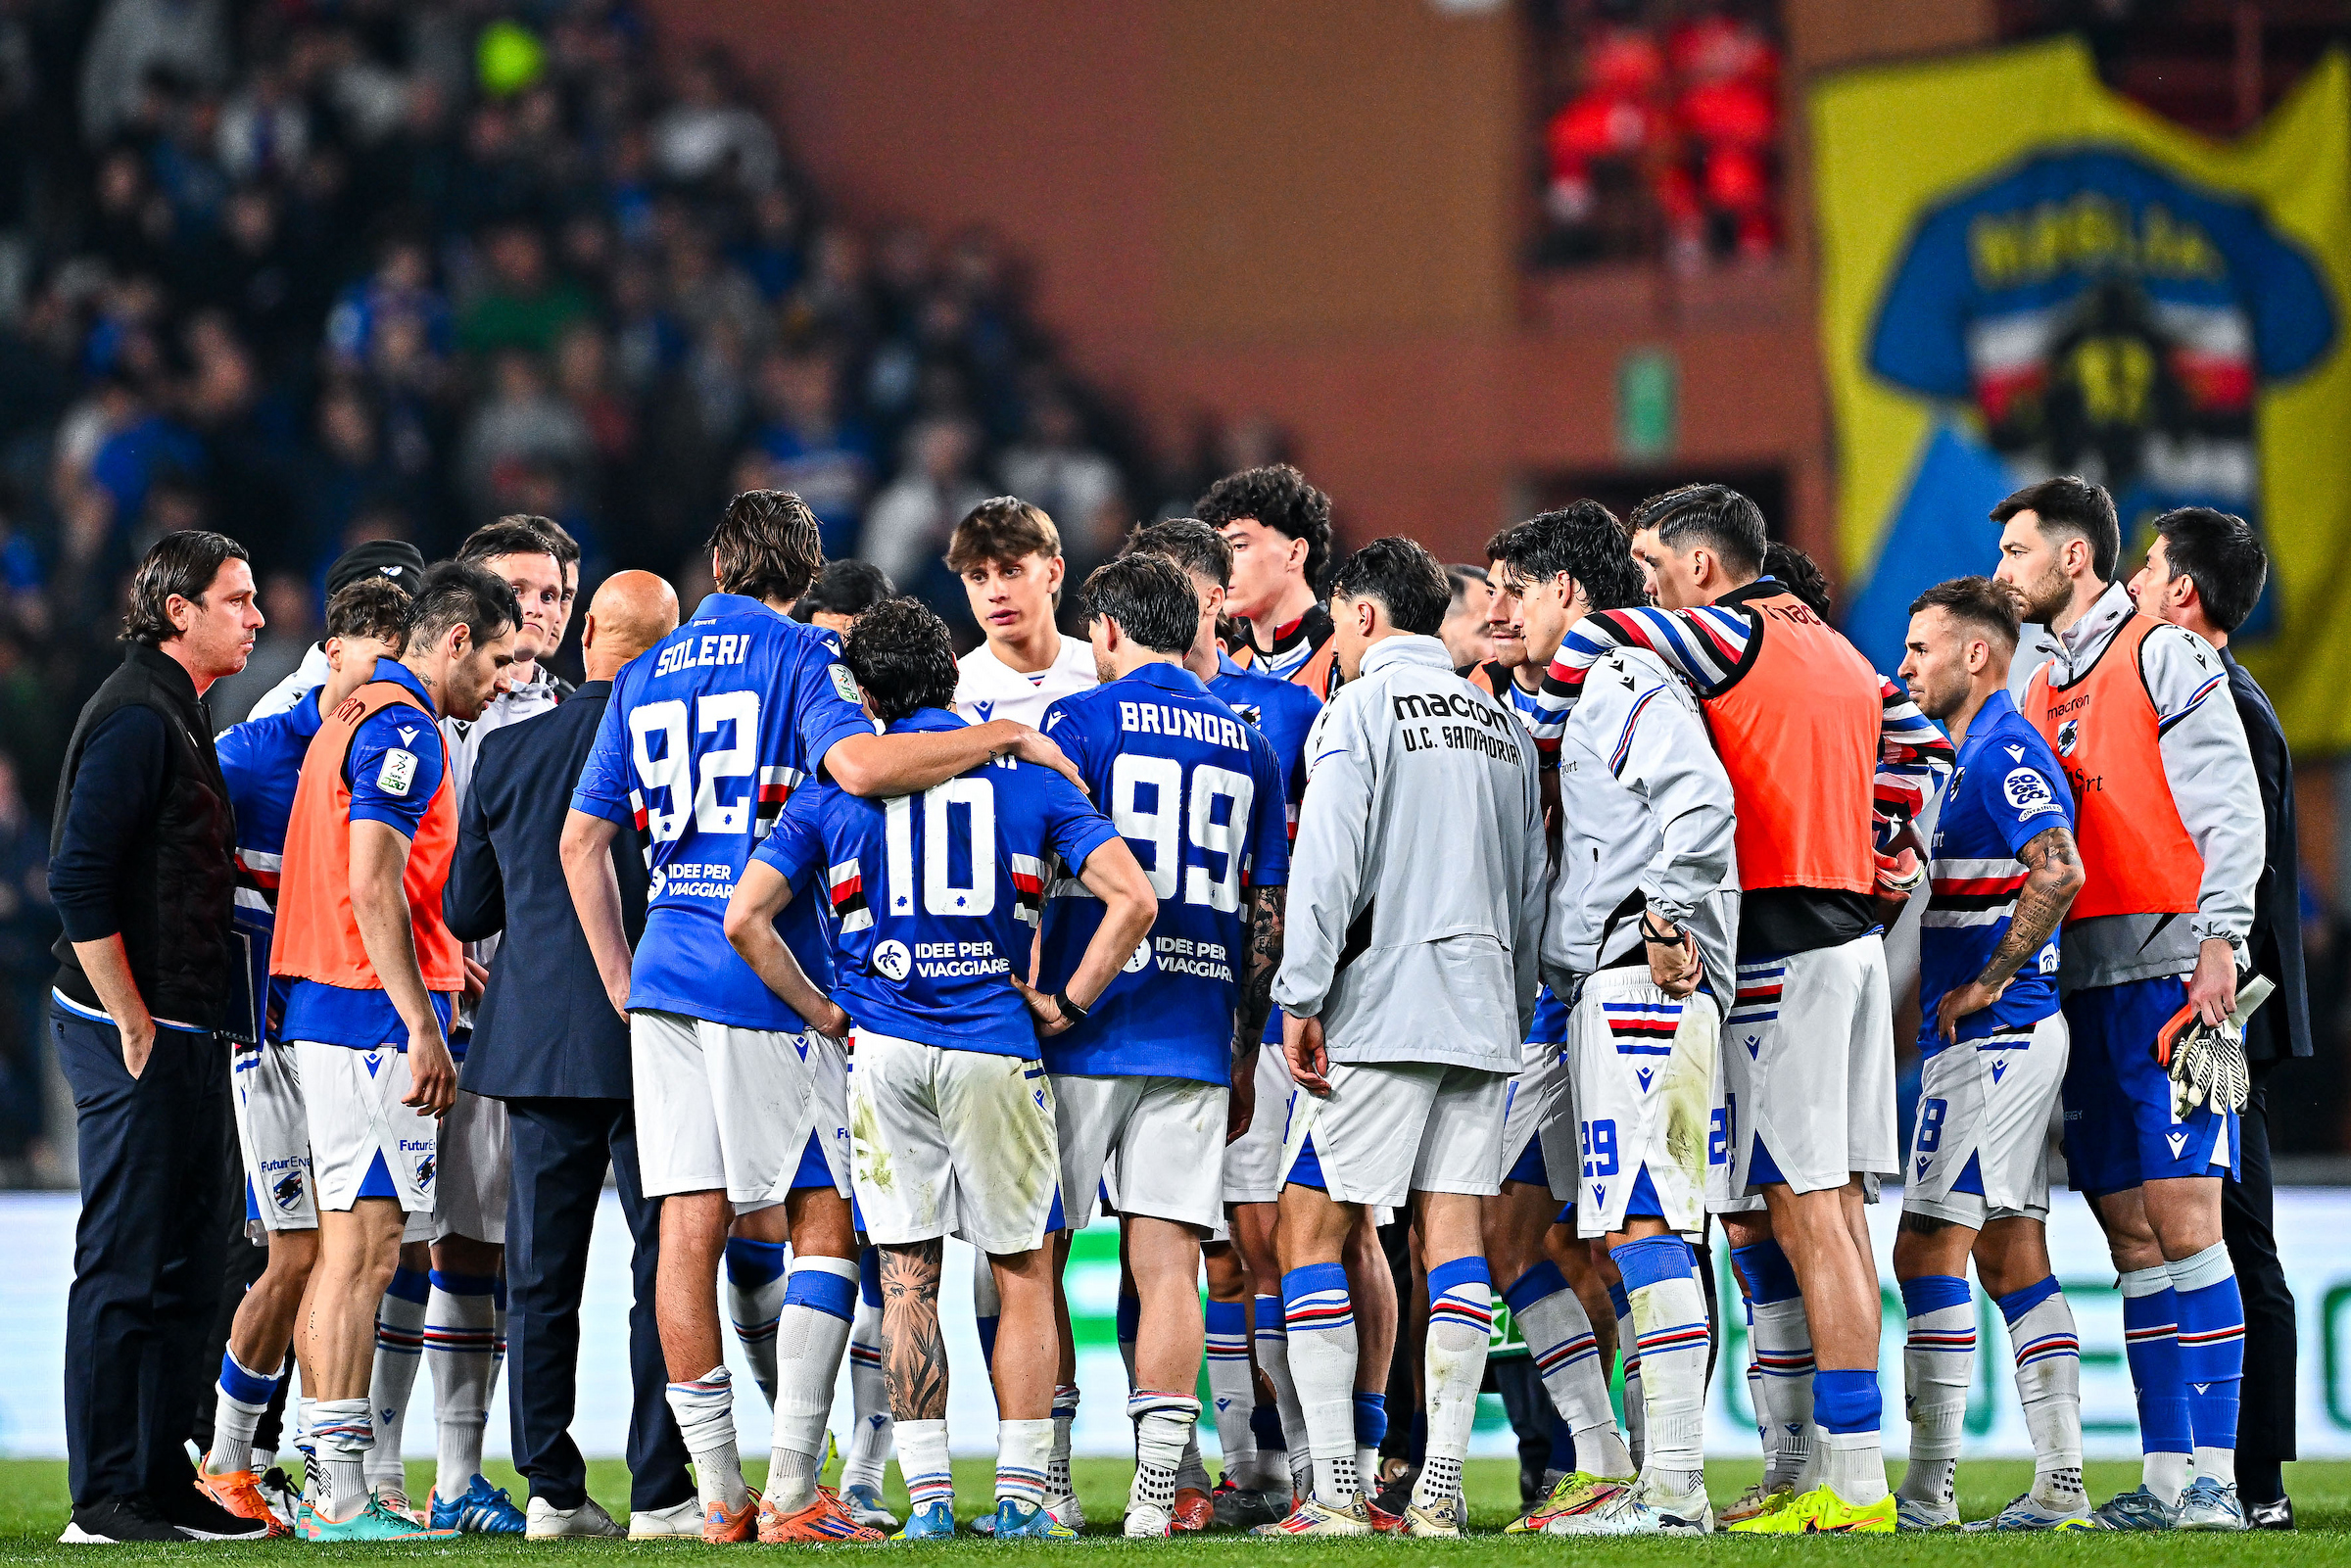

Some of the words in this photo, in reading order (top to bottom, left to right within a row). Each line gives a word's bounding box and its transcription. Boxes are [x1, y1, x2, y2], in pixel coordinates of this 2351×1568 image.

[1762, 604, 1826, 630] mac
[654, 634, 750, 679] SOLERI
[1392, 693, 1511, 736] macron
[2047, 694, 2089, 722] macron
[1119, 701, 1250, 752] BRUNORI
[1403, 727, 1438, 752] U.C.
[1442, 726, 1521, 767] SAMPORIA
[628, 689, 761, 843] 92
[882, 777, 996, 917] 10
[1112, 752, 1255, 914] 99
[668, 863, 701, 879] IDEE
[702, 864, 731, 880] PER
[668, 881, 737, 899] VIAGGIAR
[915, 942, 956, 958] IDEE
[959, 941, 994, 957] PER
[1156, 935, 1194, 956] IDEE
[1196, 942, 1226, 962] PER
[915, 958, 1011, 977] VIAGGIARE
[400, 1139, 435, 1152] FuturE
